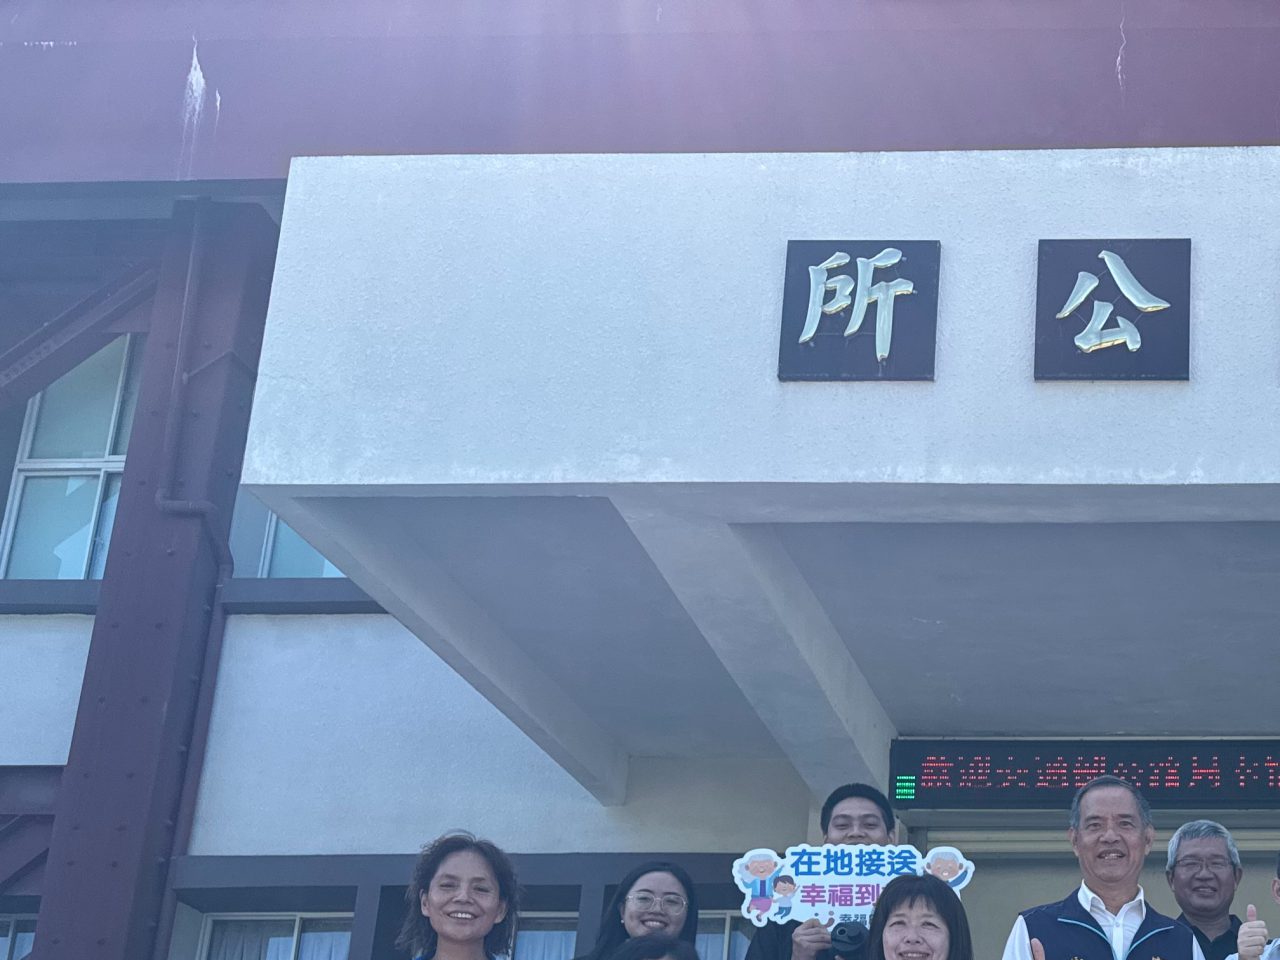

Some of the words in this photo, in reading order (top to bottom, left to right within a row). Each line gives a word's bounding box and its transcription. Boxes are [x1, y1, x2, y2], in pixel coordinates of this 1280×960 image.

[790, 848, 917, 877] 在地接送
[800, 883, 886, 907] 幸福到
